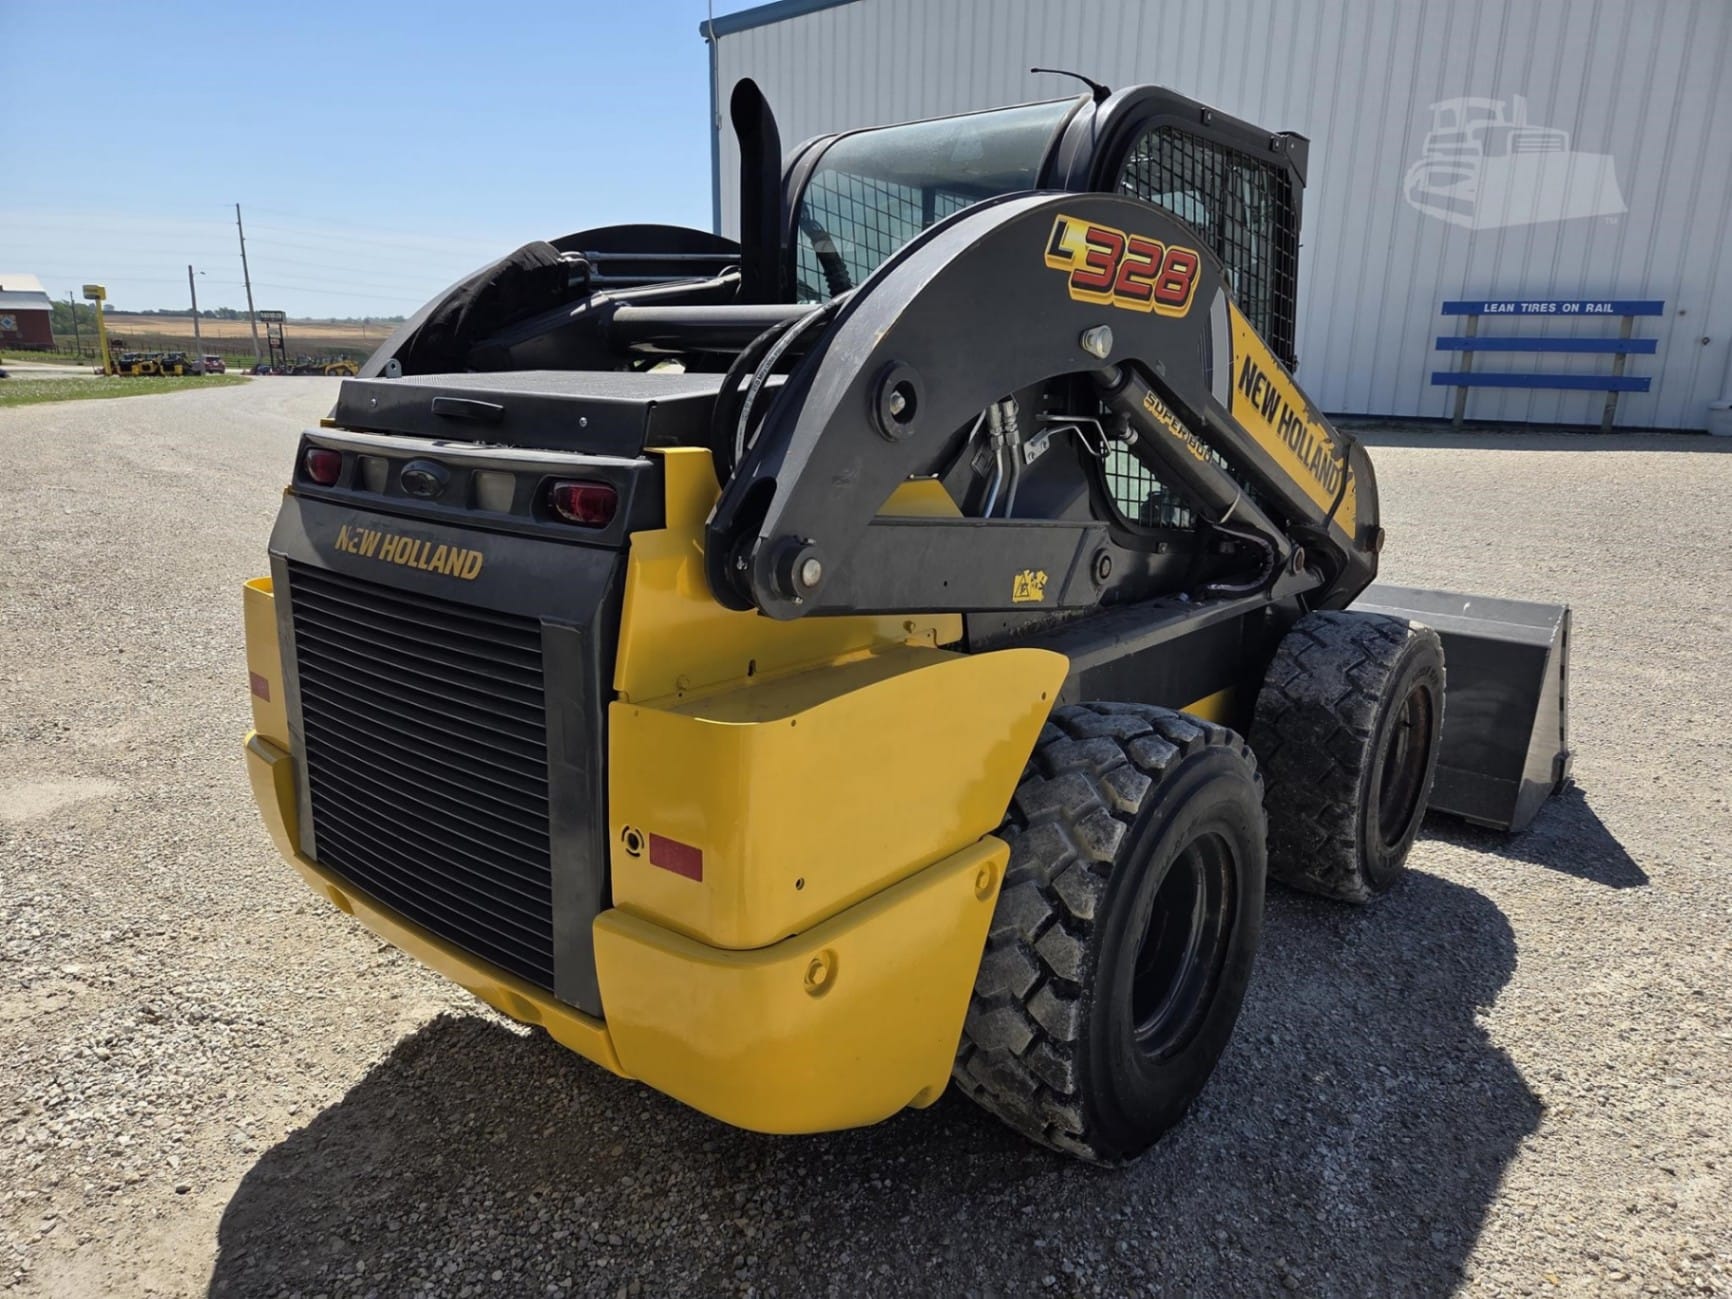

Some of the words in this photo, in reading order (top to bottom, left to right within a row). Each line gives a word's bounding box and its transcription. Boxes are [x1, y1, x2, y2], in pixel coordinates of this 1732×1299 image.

[1044, 214, 1201, 318] L328
[1483, 302, 1515, 313] LEAN
[1520, 302, 1557, 313] TIRES
[1561, 302, 1580, 313] ON
[1585, 303, 1614, 313] RAIL
[1238, 353, 1282, 425] NEW
[1276, 401, 1342, 496] HOLLAND
[334, 524, 382, 557] NEW
[378, 533, 484, 580] HOLLAND
